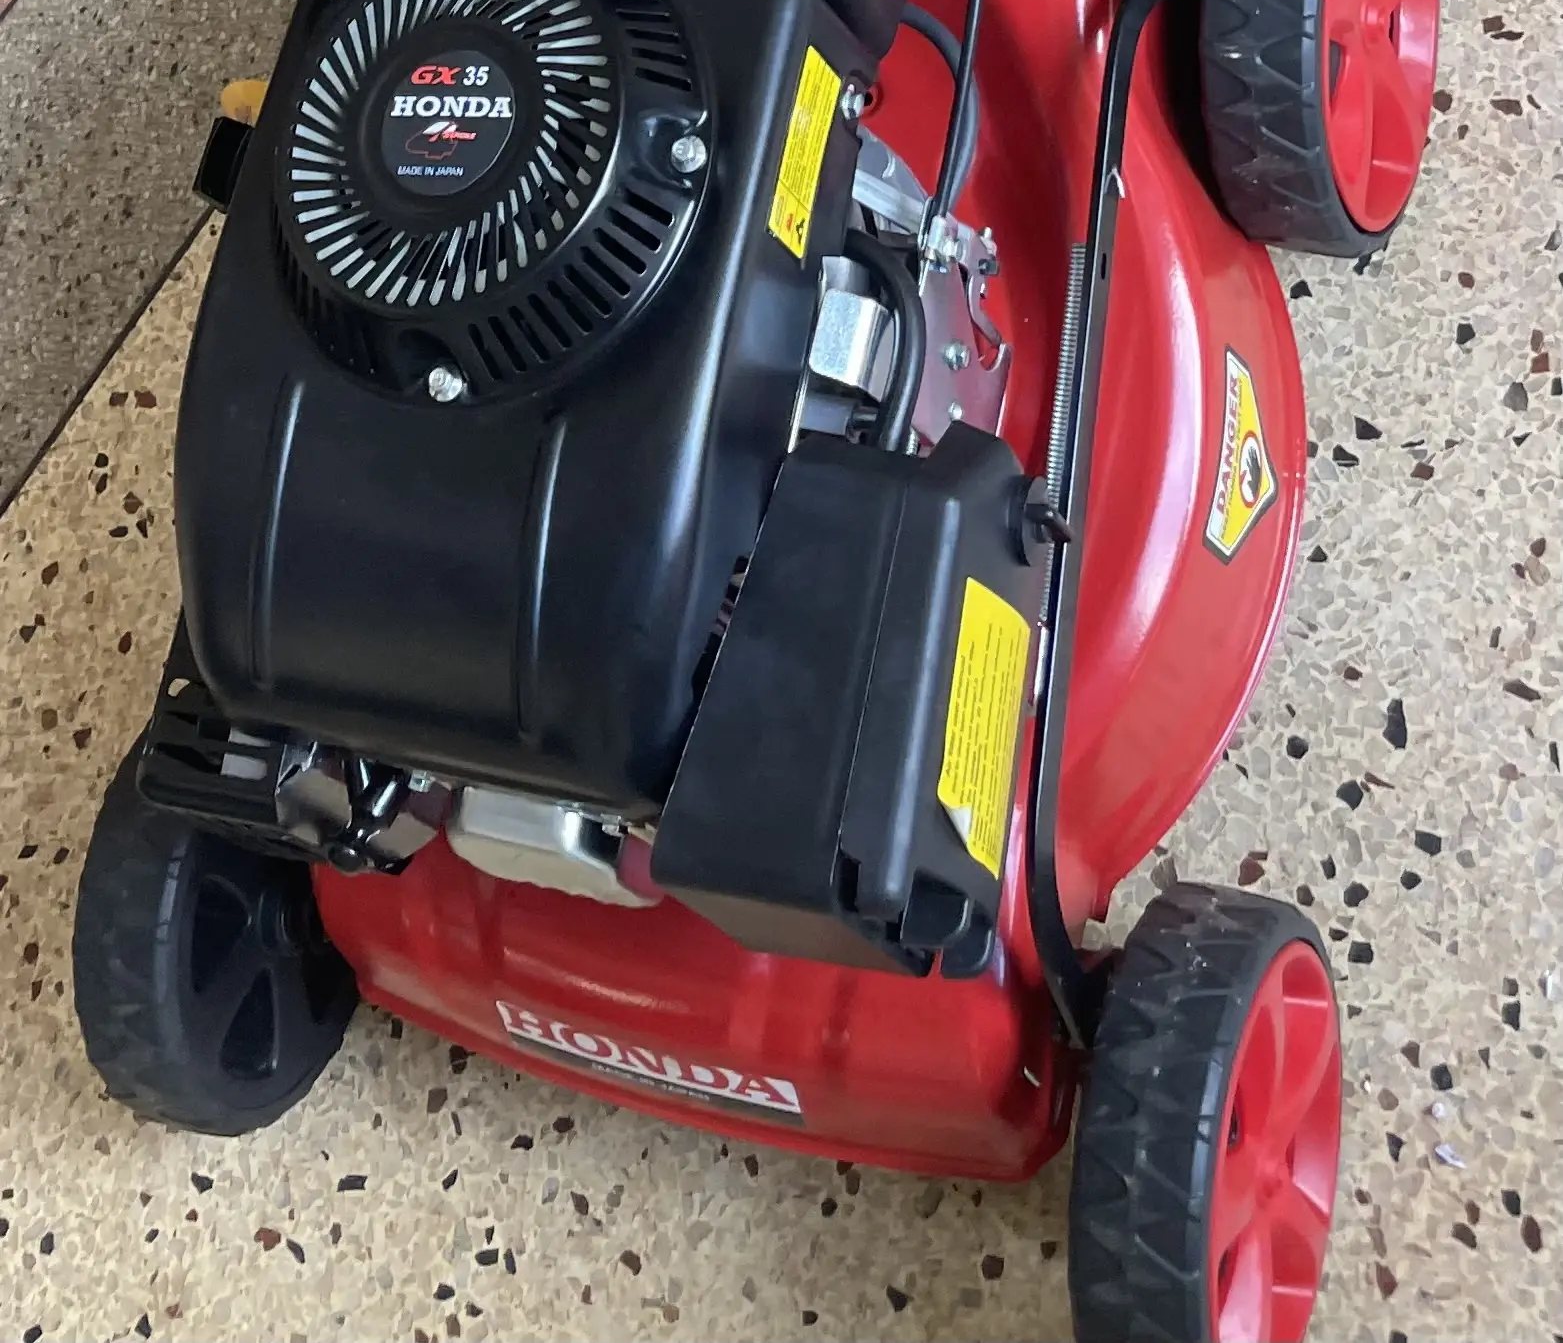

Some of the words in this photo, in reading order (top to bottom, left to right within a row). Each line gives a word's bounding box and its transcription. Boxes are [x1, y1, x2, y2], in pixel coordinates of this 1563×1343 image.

[410, 65, 461, 85] GX
[462, 65, 490, 86] 35
[390, 95, 513, 118] HONDA
[397, 165, 423, 176] MADE
[424, 166, 435, 176] IN
[435, 166, 464, 177] JAPAN
[1216, 375, 1242, 516] DANGER
[501, 1004, 795, 1105] HONDA
